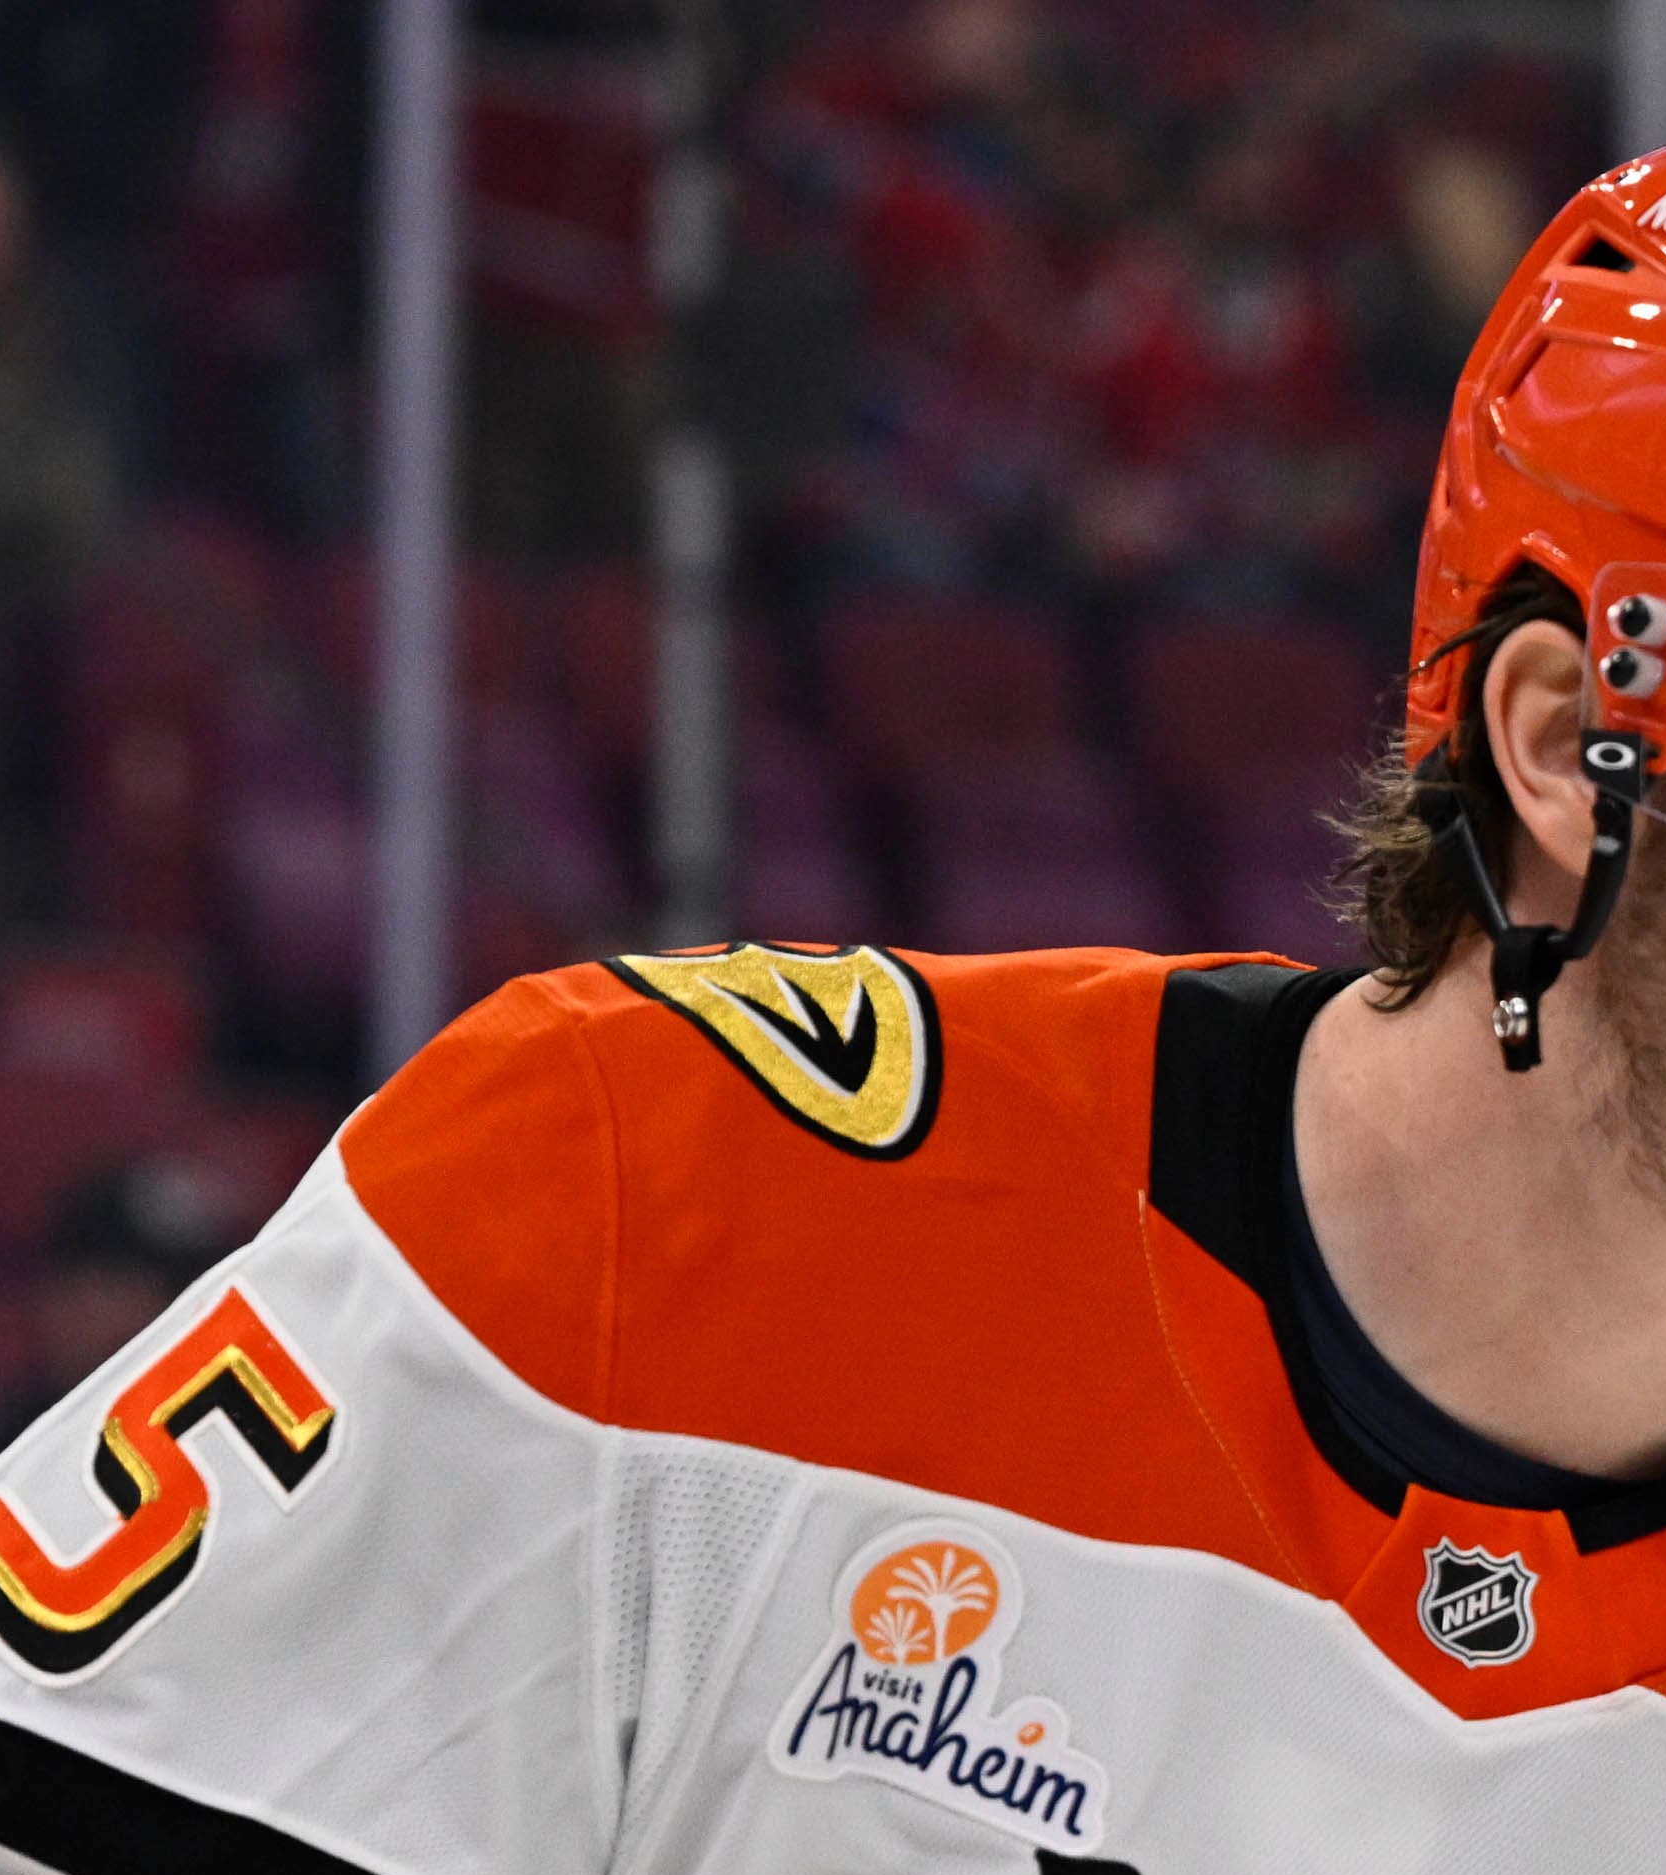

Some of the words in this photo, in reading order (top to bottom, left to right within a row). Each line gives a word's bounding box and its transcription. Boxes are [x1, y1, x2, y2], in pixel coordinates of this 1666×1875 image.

[1441, 1583, 1512, 1633] NHL
[863, 1668, 925, 1705] visit
[787, 1641, 1088, 1837] Anaheim
